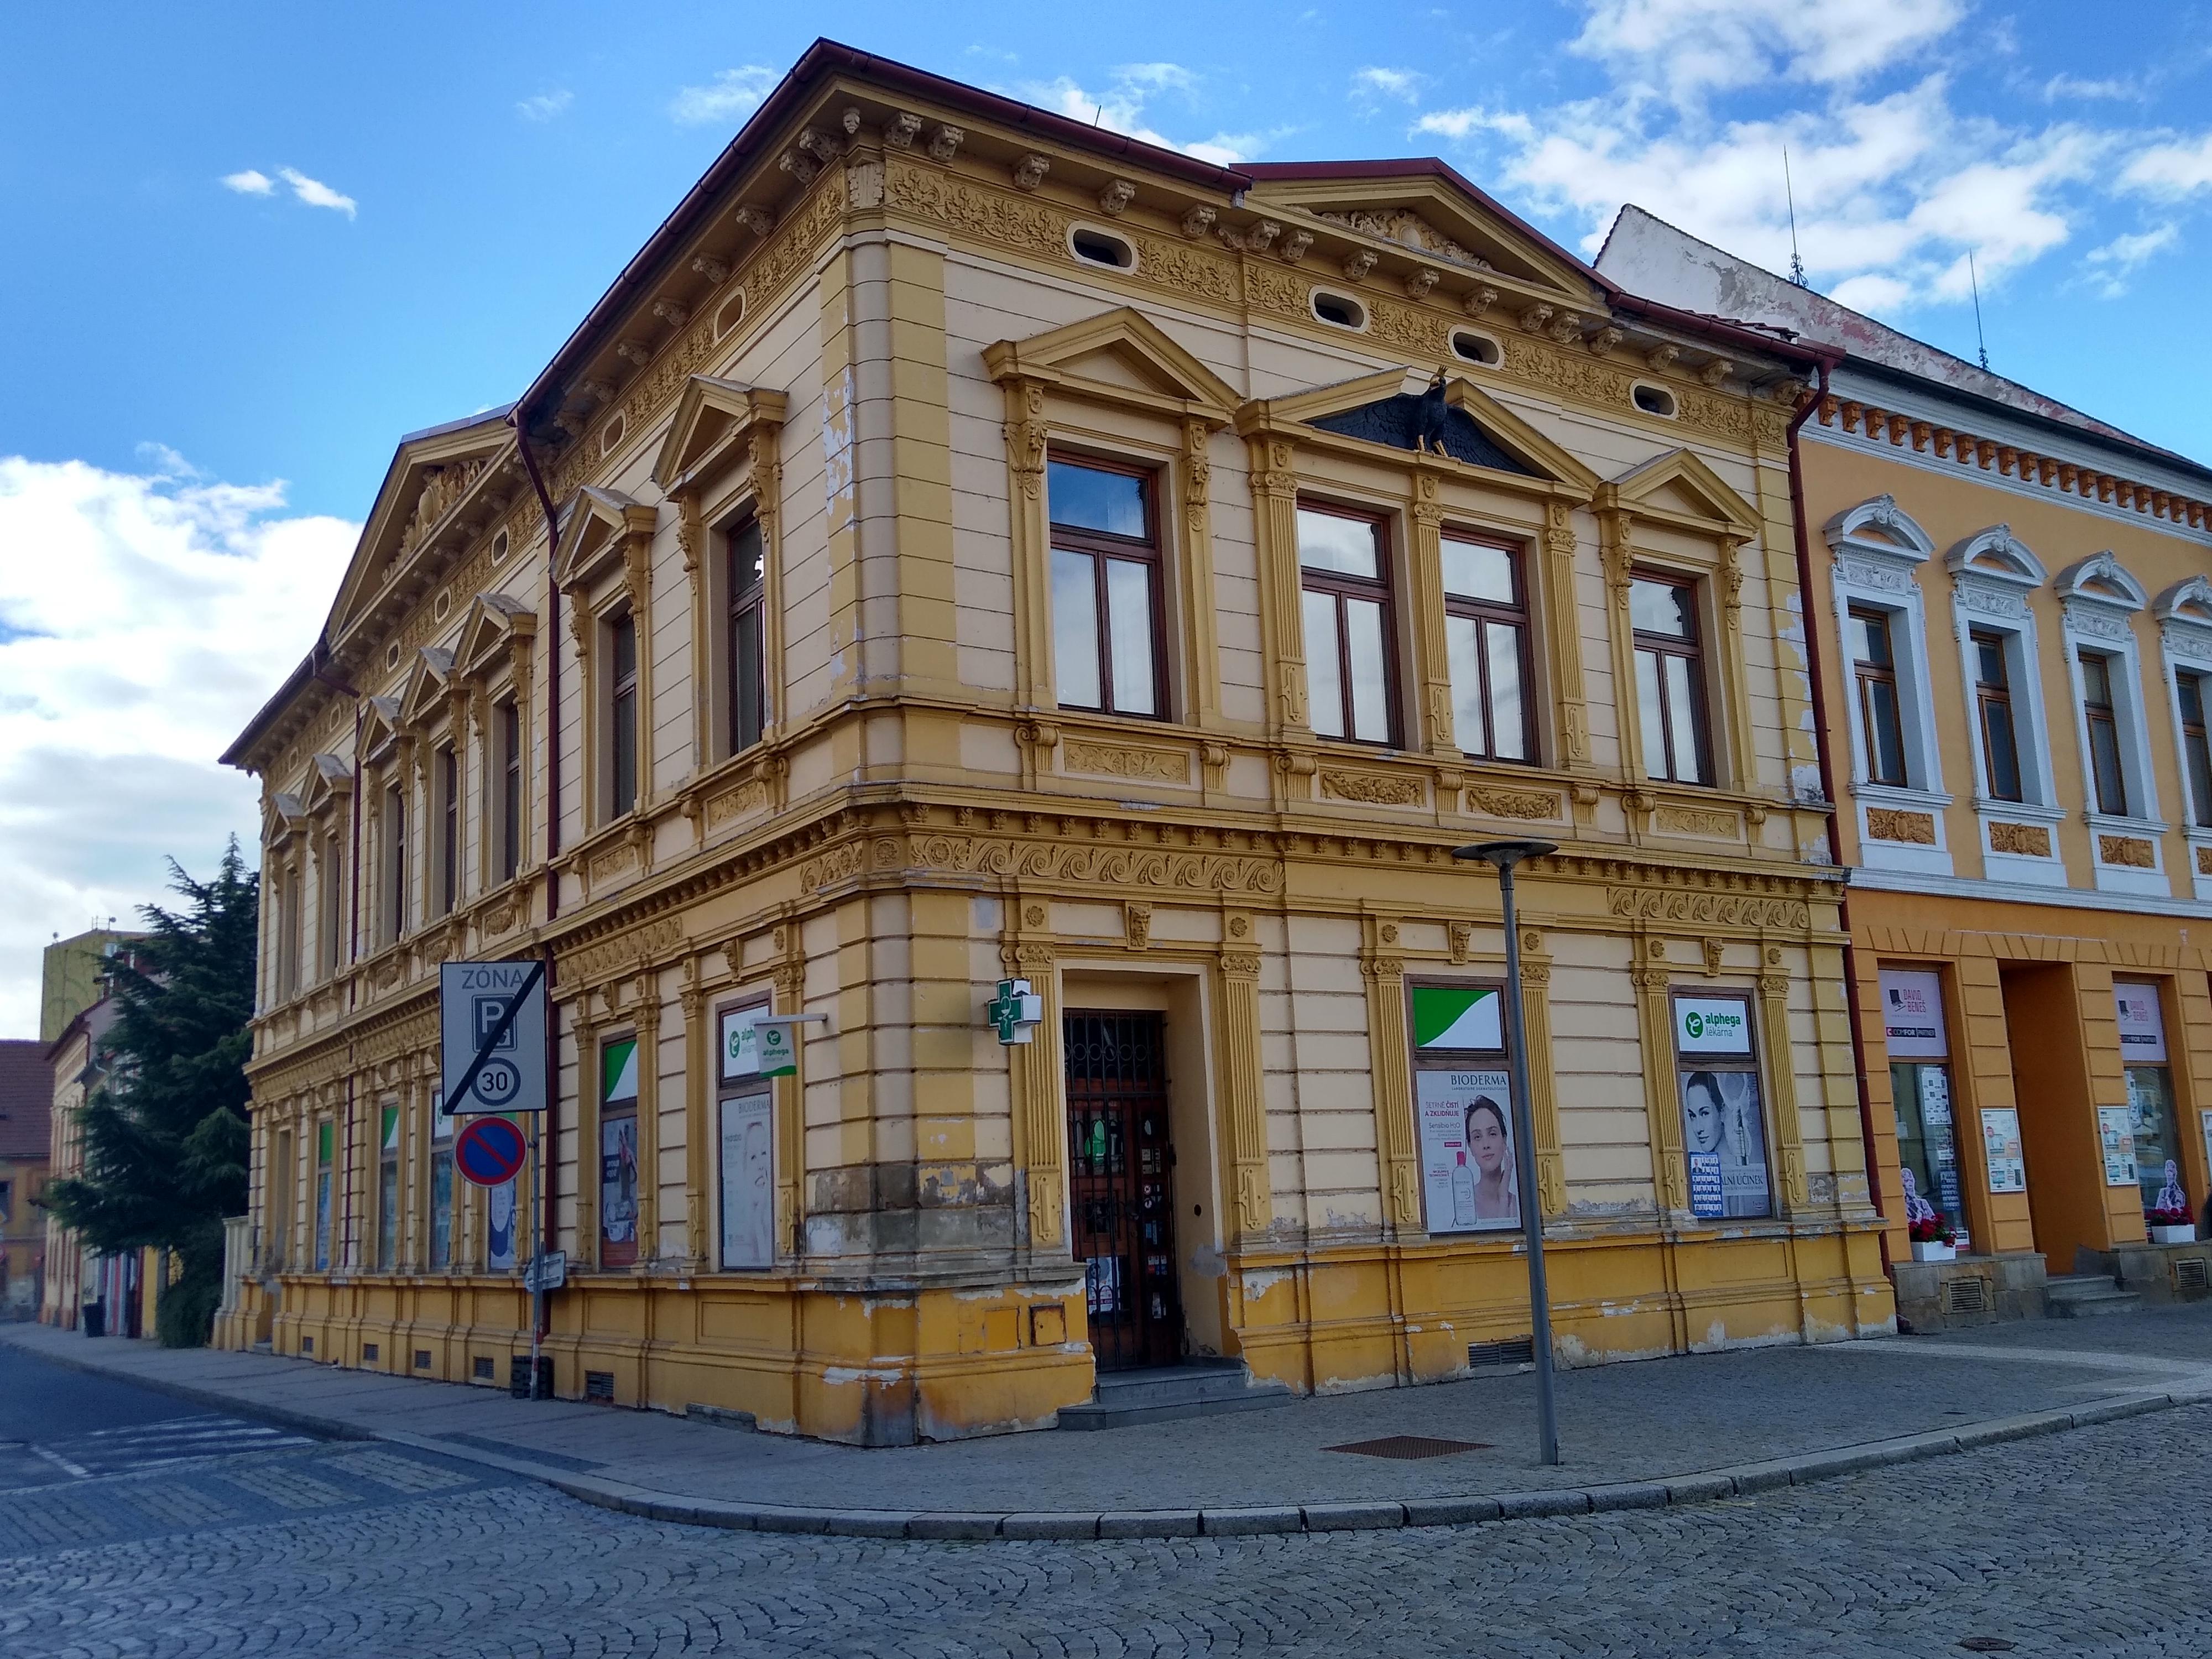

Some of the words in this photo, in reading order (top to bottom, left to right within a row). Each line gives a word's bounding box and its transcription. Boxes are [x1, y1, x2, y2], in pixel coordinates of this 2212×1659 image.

[461, 965, 524, 989] ZÓNA
[1903, 989, 1921, 1000] DAVID
[1907, 1000, 1927, 1013] BENEŠ
[481, 1001, 505, 1034] P
[1705, 1012, 1741, 1027] alphega
[1706, 1026, 1733, 1037] lékárna
[482, 1072, 508, 1092] 30
[1451, 1074, 1507, 1086] BIODERMA
[1430, 1109, 1460, 1117] ZKLIDŇUJE
[1736, 1172, 1764, 1186] ÚČINEK
